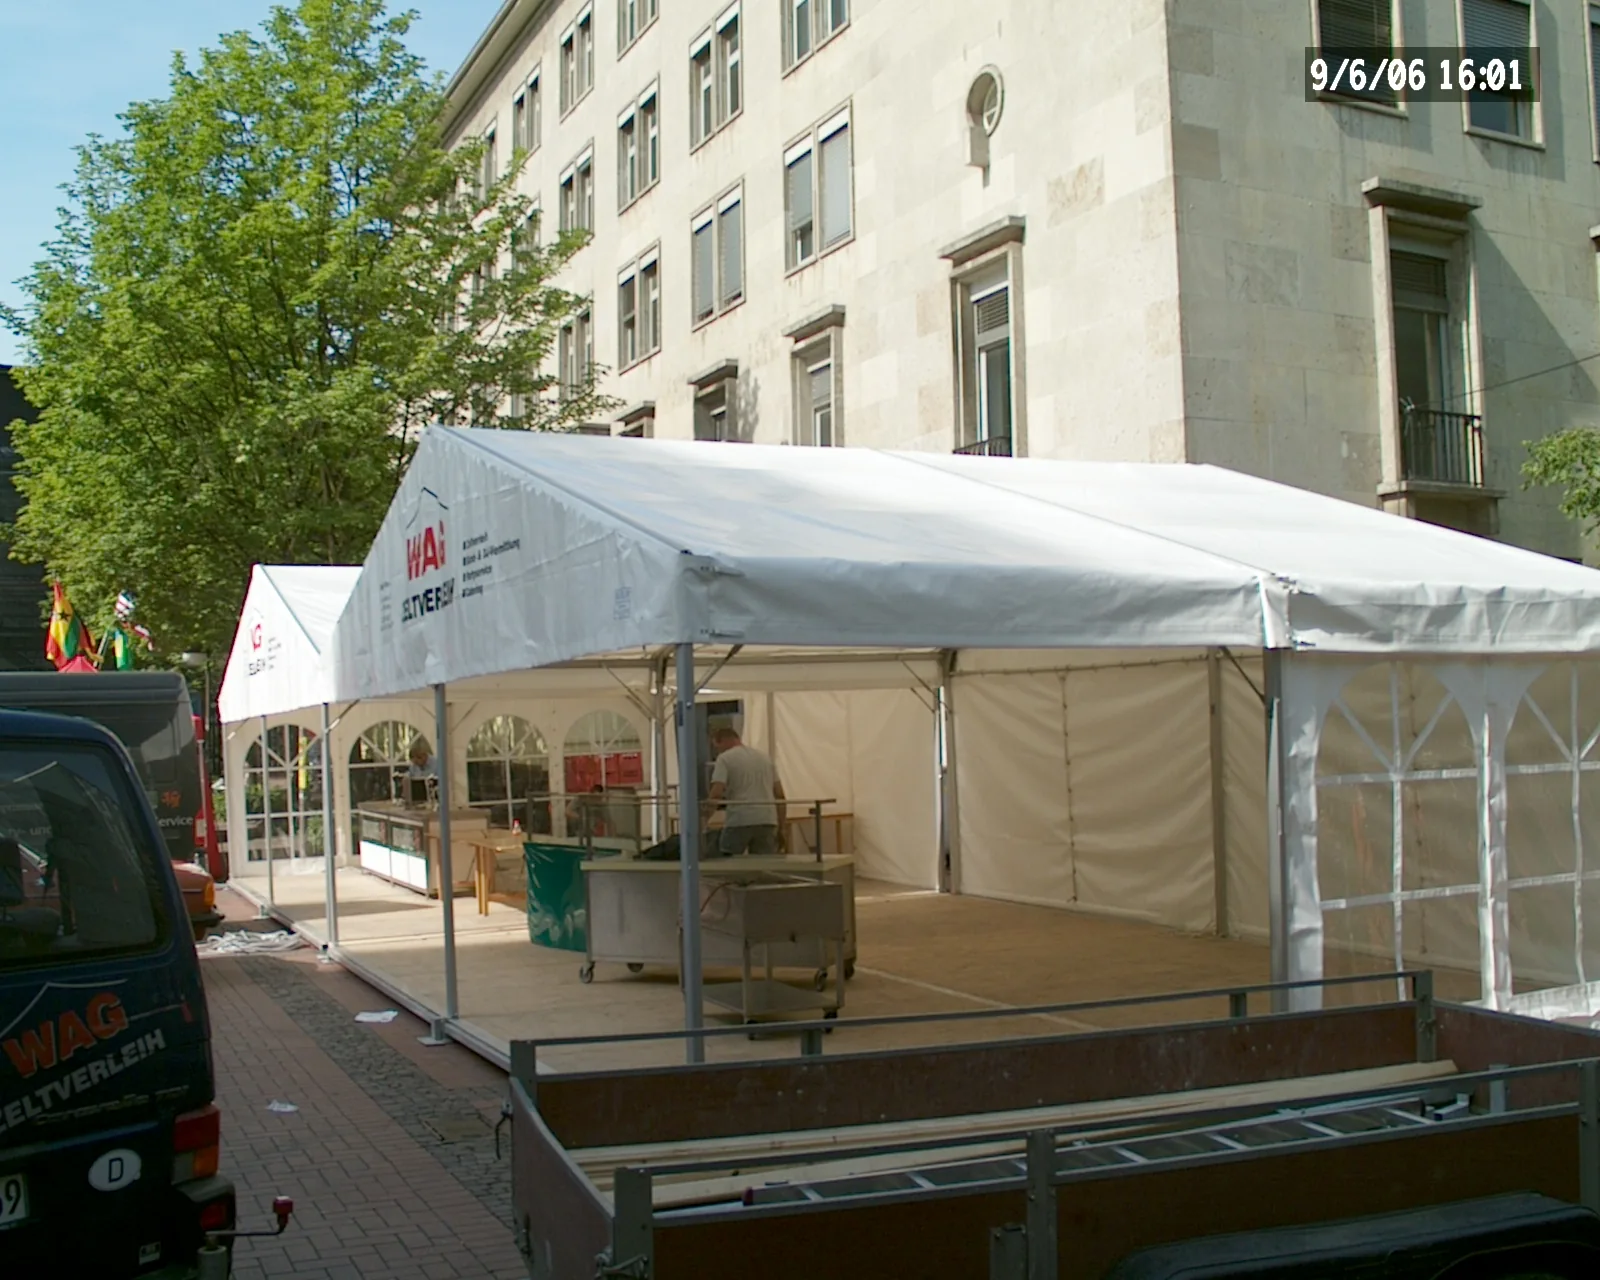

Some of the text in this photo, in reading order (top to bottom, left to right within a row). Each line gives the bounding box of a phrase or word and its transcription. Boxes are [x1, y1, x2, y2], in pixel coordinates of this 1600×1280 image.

[157, 816, 193, 827] ervice
[2, 991, 129, 1079] WAG
[0, 1028, 167, 1131] ELTVERLEIH
[108, 1157, 124, 1184] D
